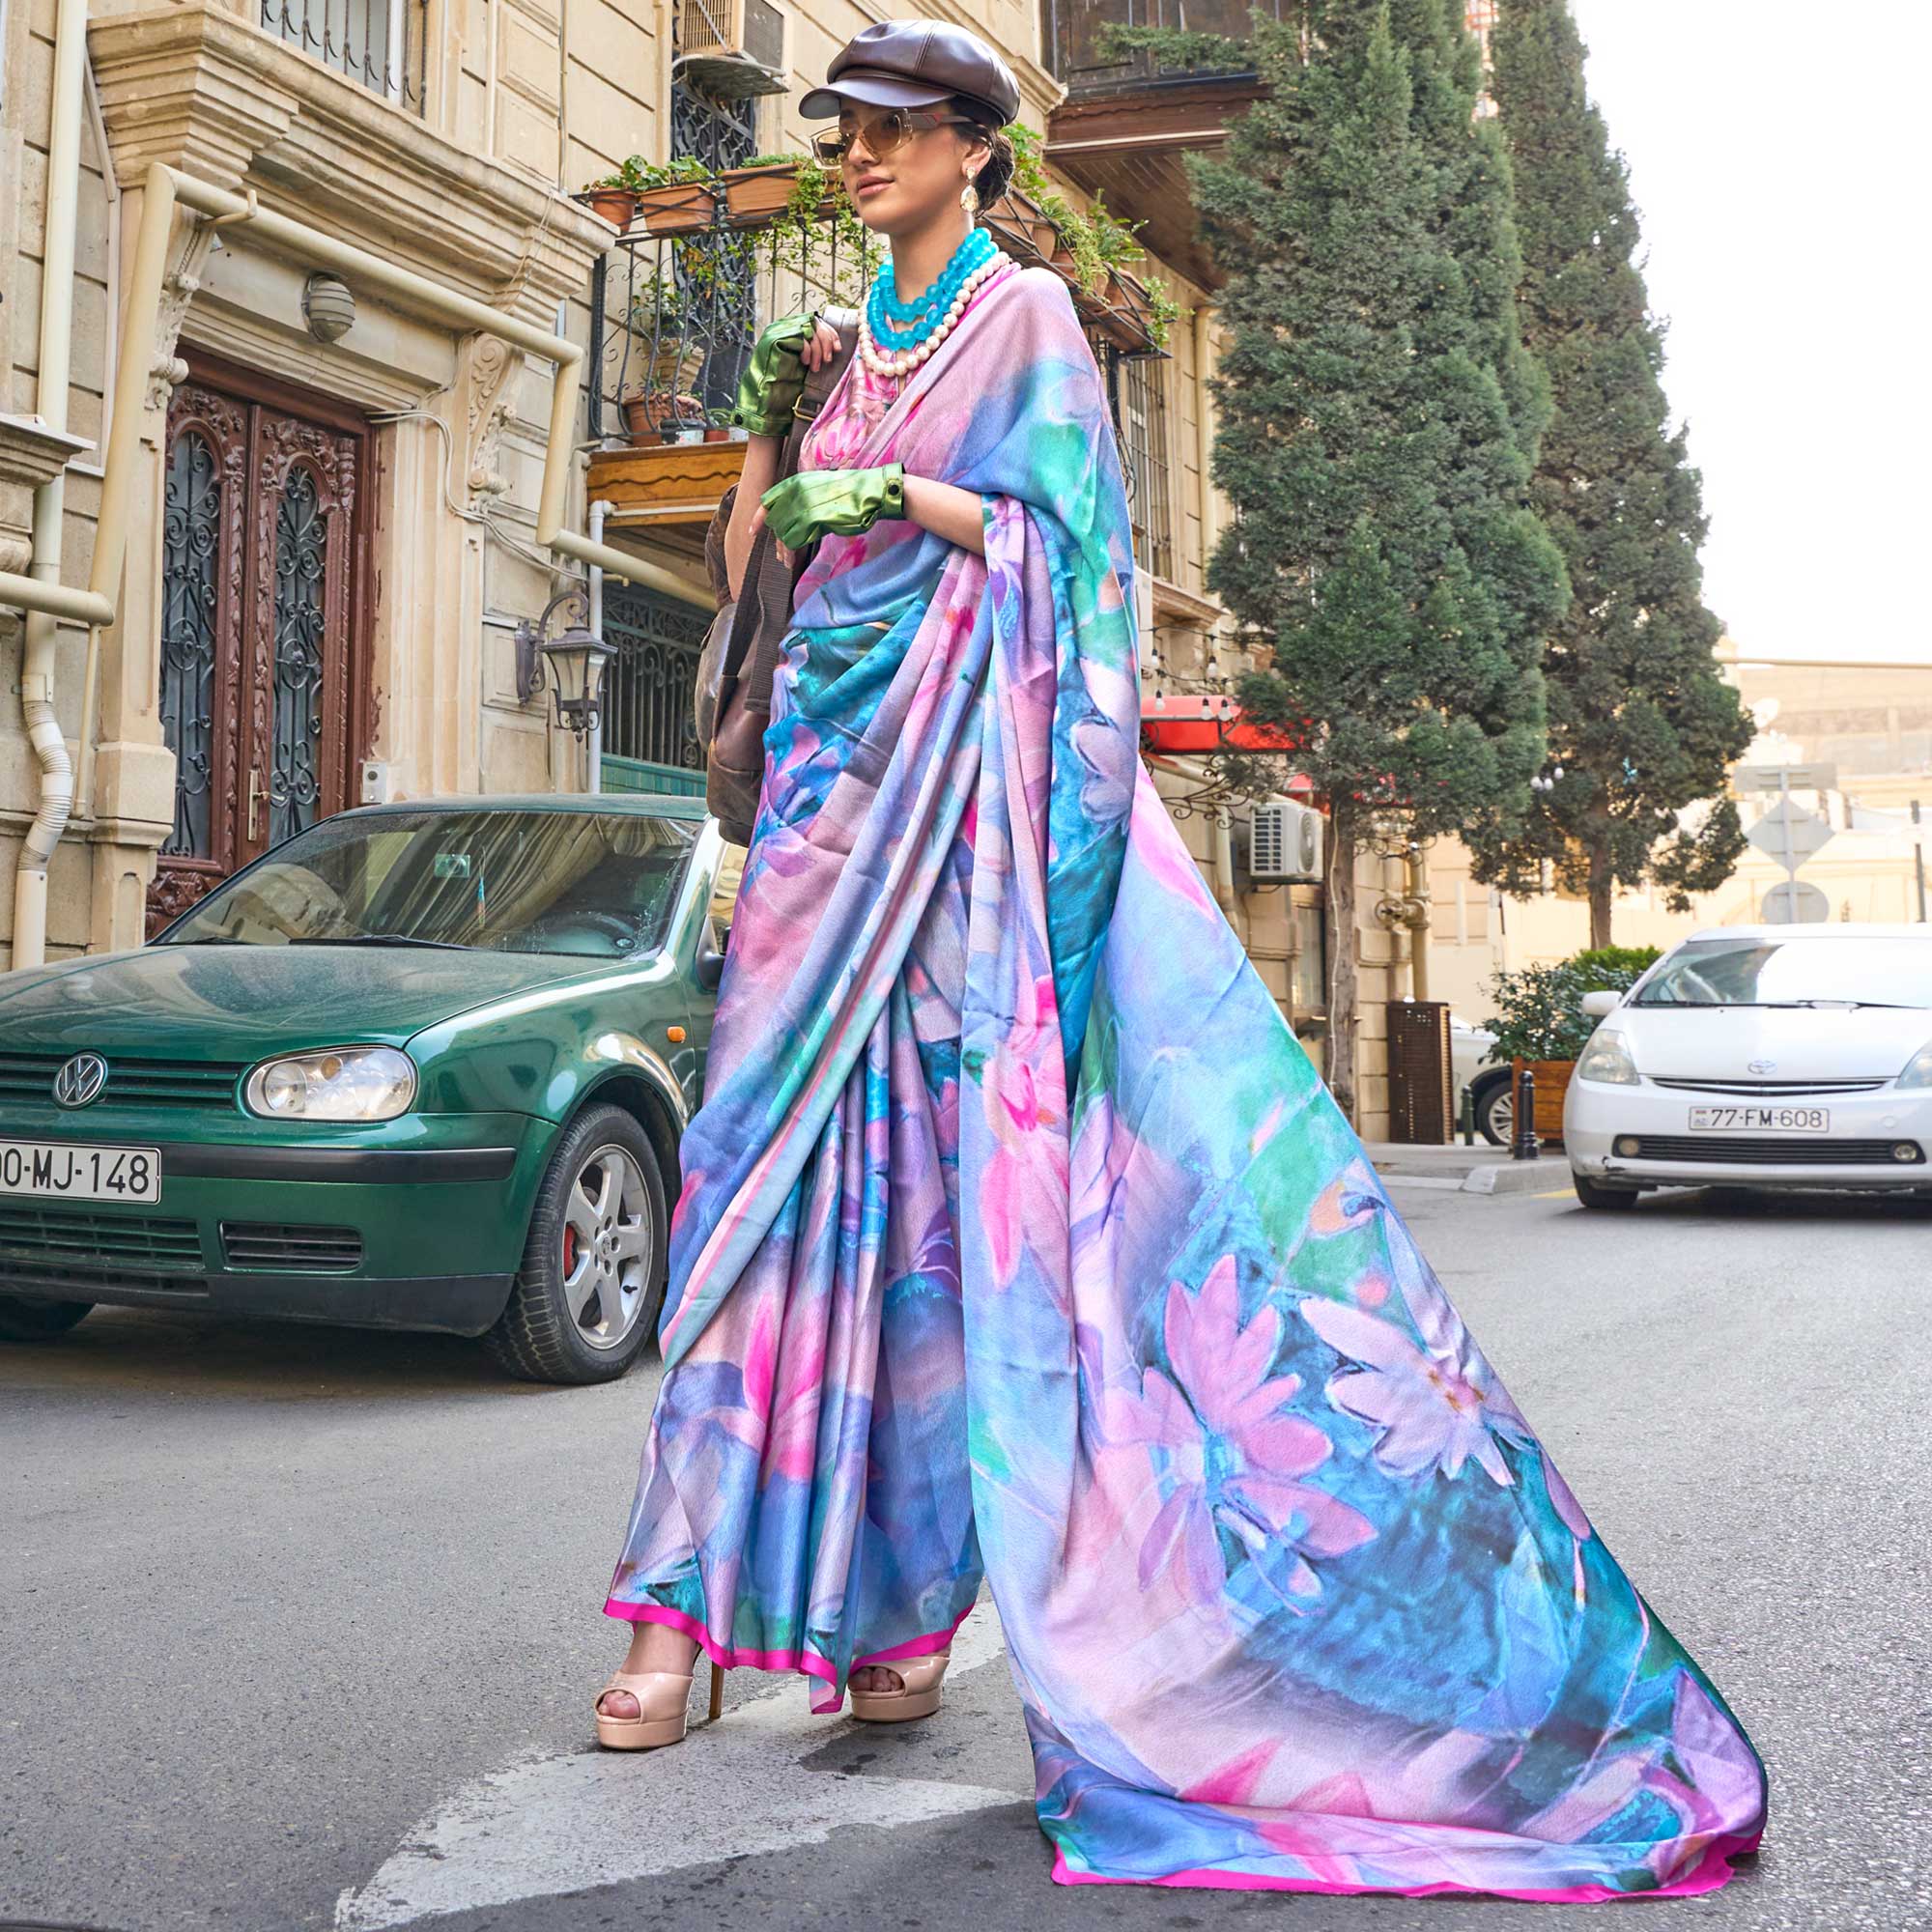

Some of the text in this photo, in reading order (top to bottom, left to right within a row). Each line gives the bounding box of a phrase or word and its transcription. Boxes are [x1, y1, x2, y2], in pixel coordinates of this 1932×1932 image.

[59, 1055, 102, 1104] VW
[1711, 1108, 1822, 1128] 77-FM-608
[0, 1148, 149, 1194] 0-MJ-148
